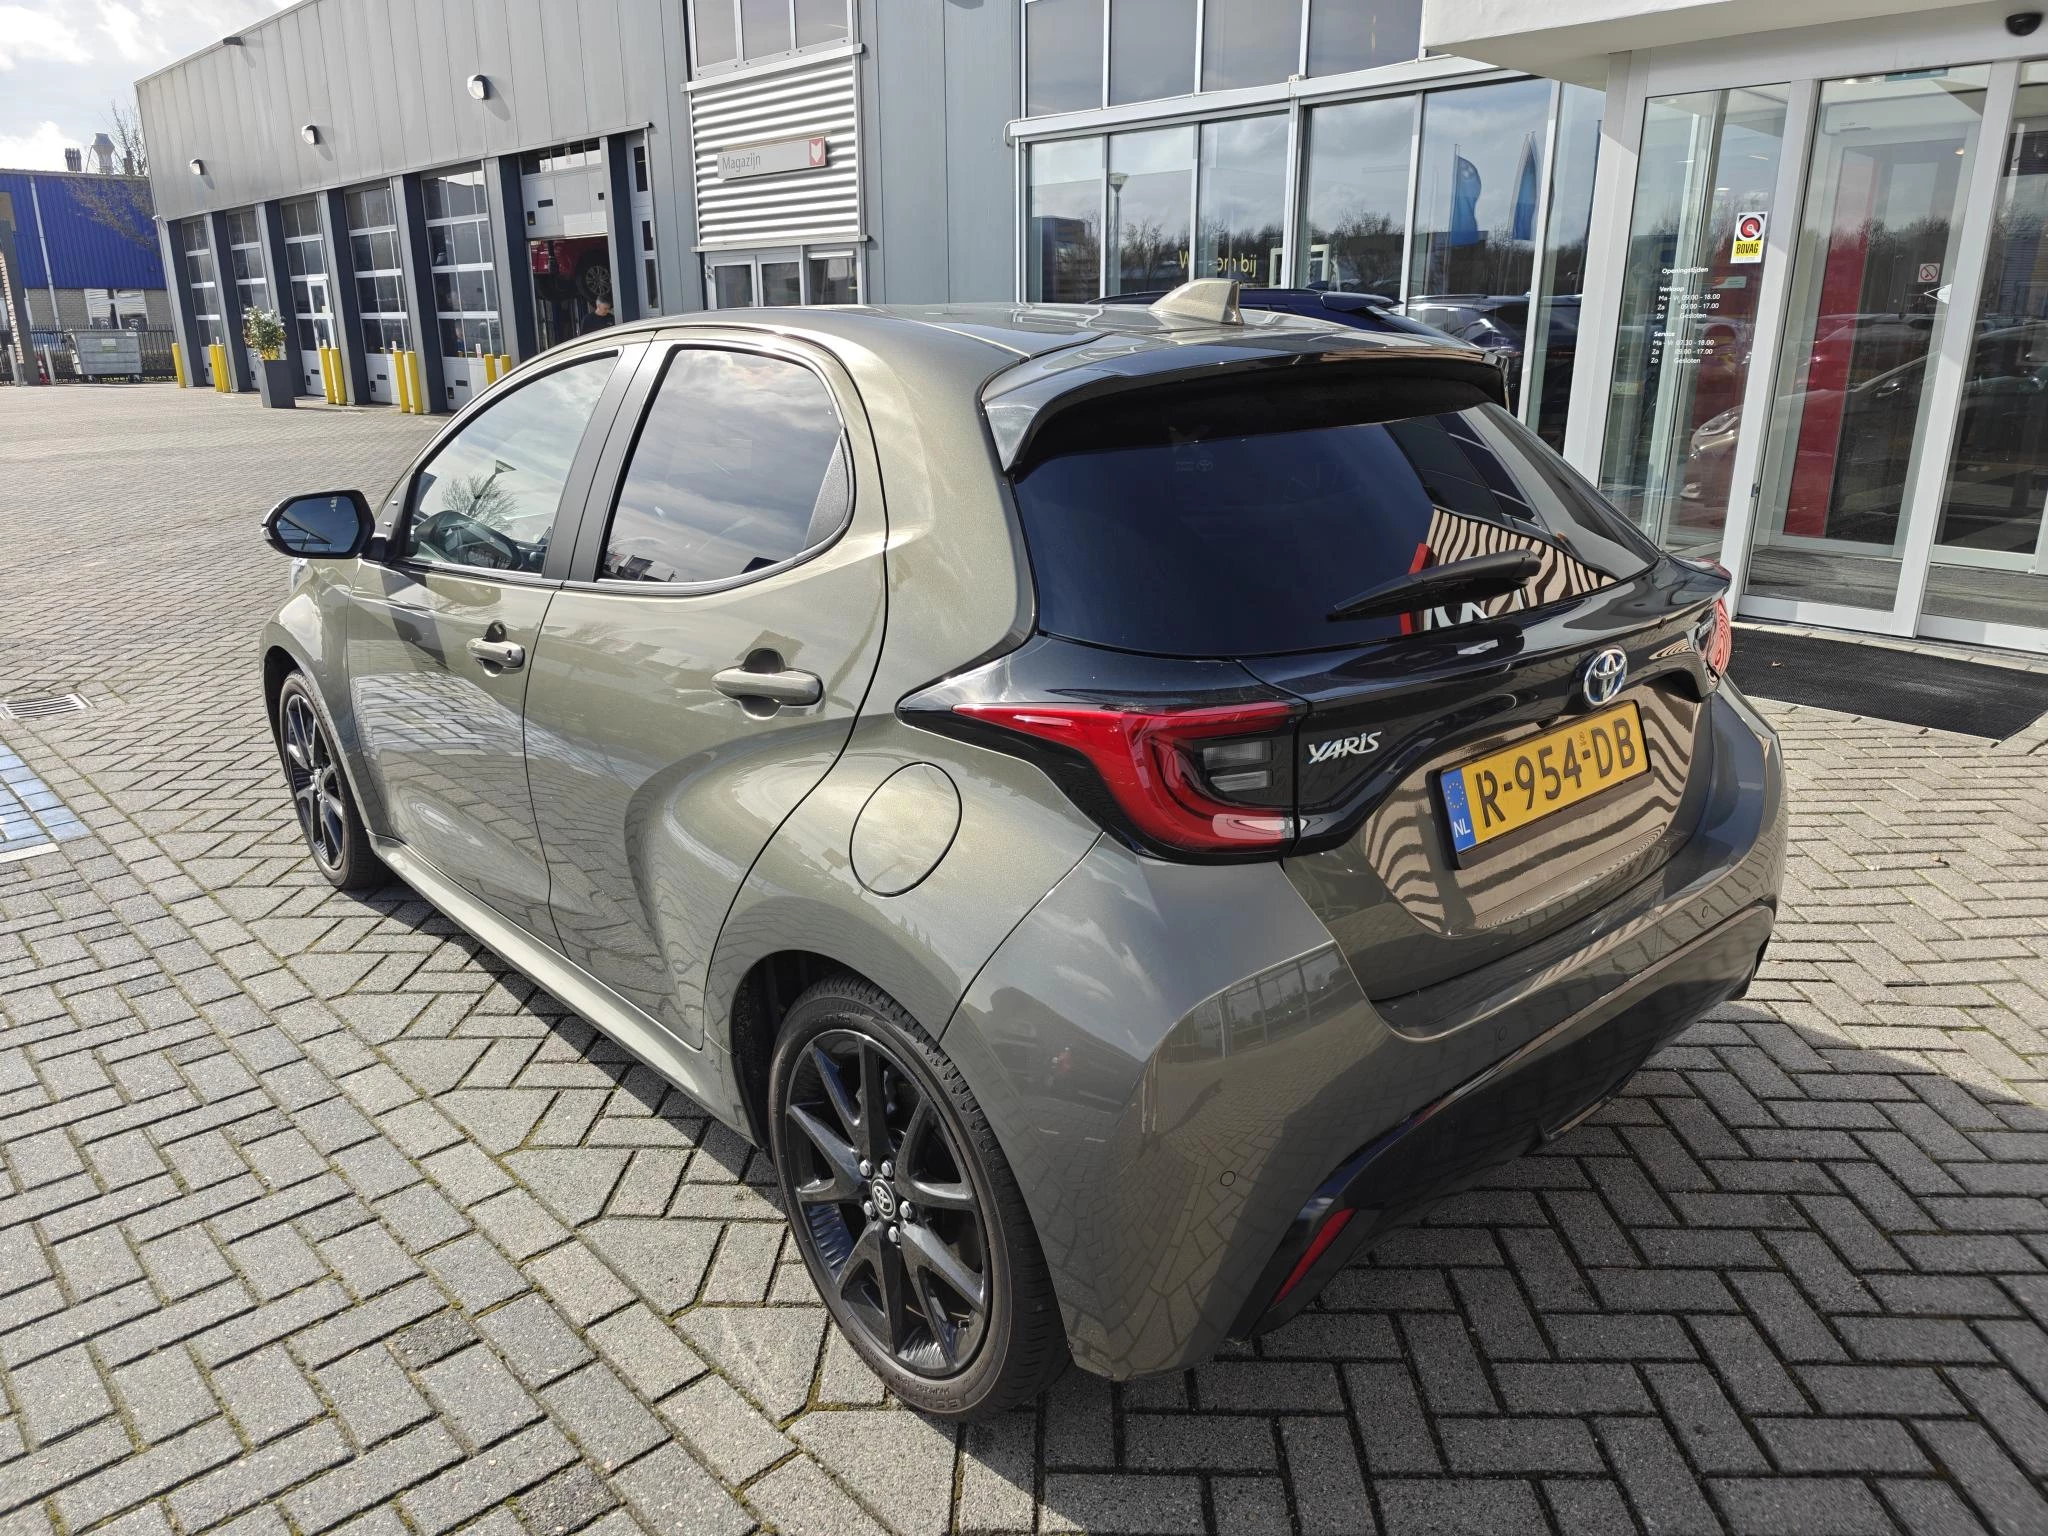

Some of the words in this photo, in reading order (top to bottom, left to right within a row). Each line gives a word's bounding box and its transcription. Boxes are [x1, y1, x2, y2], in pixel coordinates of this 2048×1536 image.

[722, 153, 761, 172] Magazijn
[1736, 243, 1759, 254] BOVAG
[1241, 253, 1257, 278] bij
[1661, 266, 1709, 275] Openingstijden
[1308, 731, 1382, 764] YARIS
[1475, 718, 1636, 828] R-954-DB
[1453, 819, 1471, 838] NL
